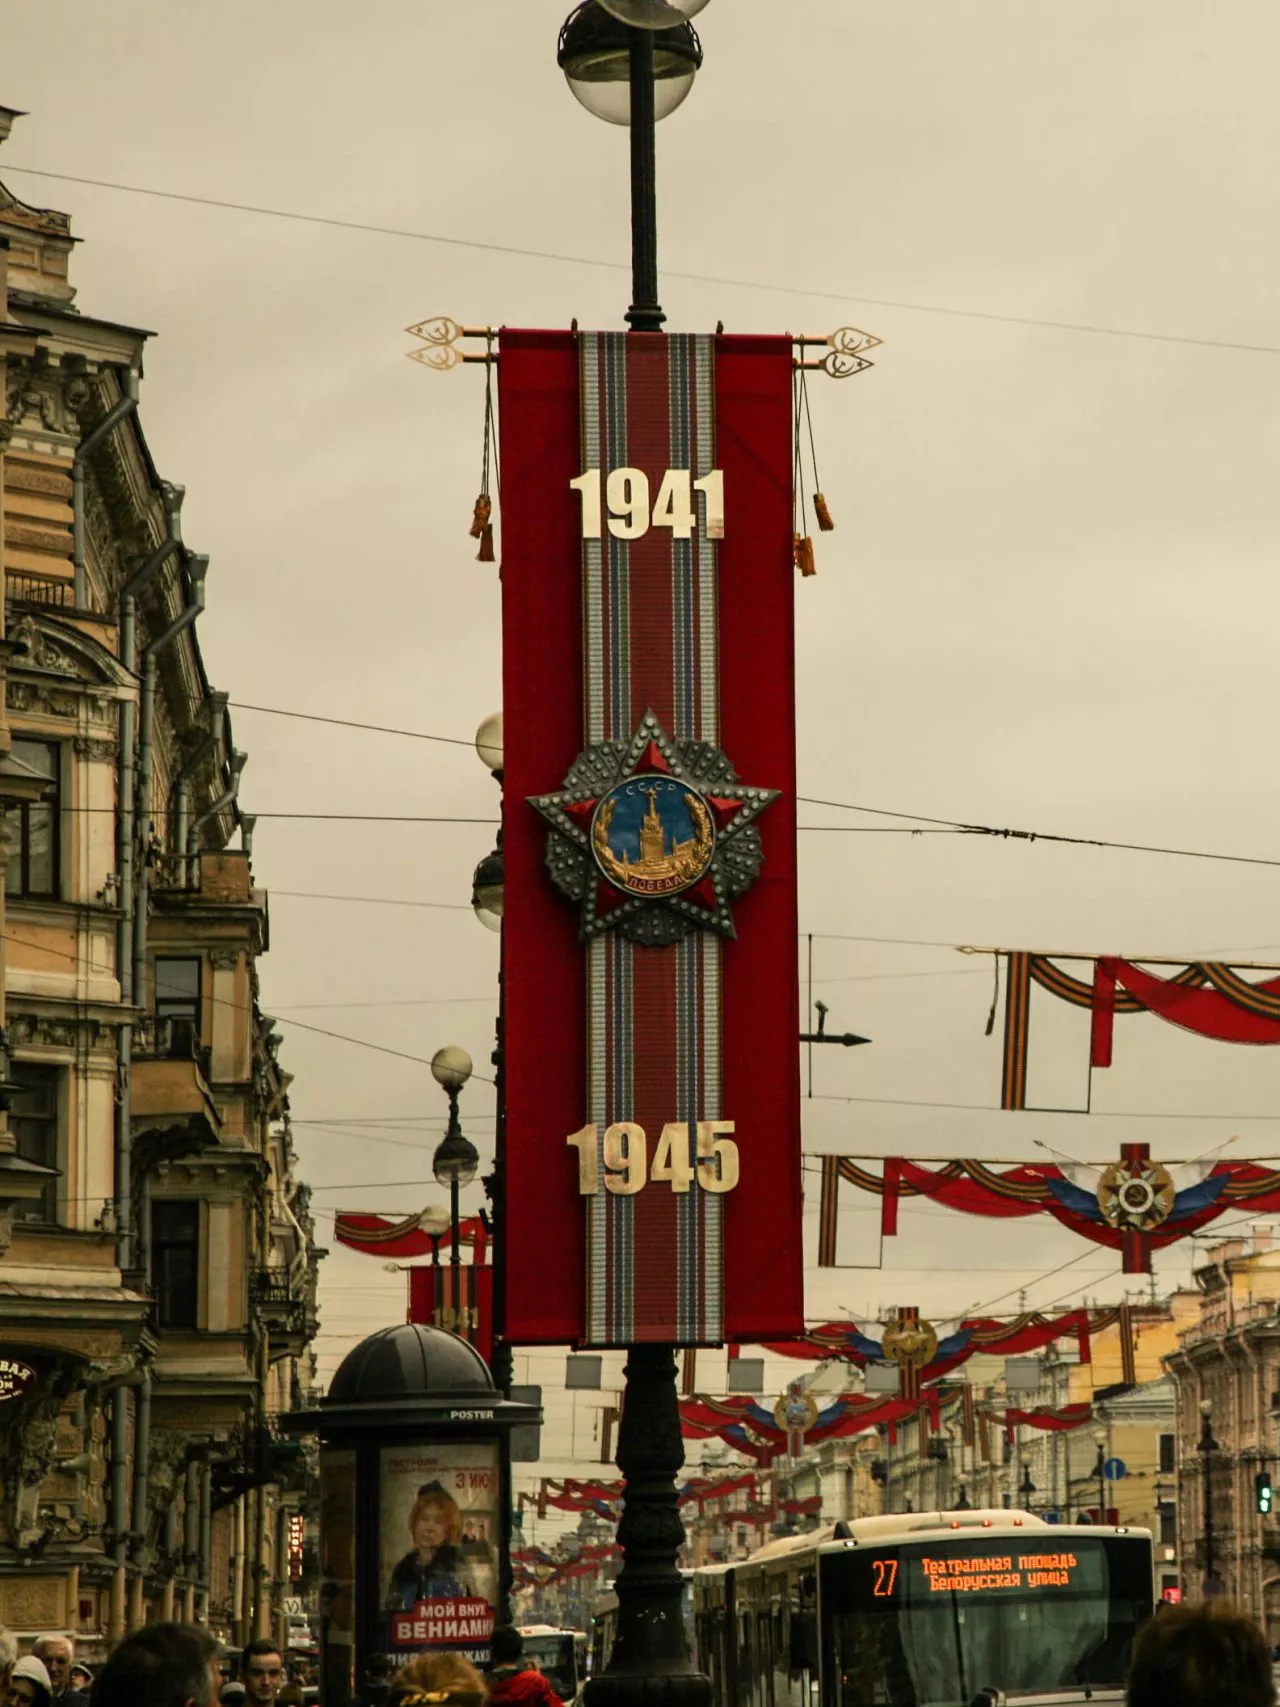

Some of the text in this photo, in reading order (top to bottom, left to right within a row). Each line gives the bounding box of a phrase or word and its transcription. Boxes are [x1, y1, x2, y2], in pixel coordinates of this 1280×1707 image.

[570, 468, 724, 539] 1941
[625, 781, 677, 796] СССР
[629, 875, 684, 891] ПОБЕДА
[566, 1120, 739, 1195] 1945
[450, 1410, 494, 1420] POSTER
[922, 1553, 1077, 1575] Театральная площадь
[872, 1560, 899, 1596] 27
[930, 1570, 1069, 1592] Белорусская улица
[420, 1601, 487, 1618] МОЙ ВНУК
